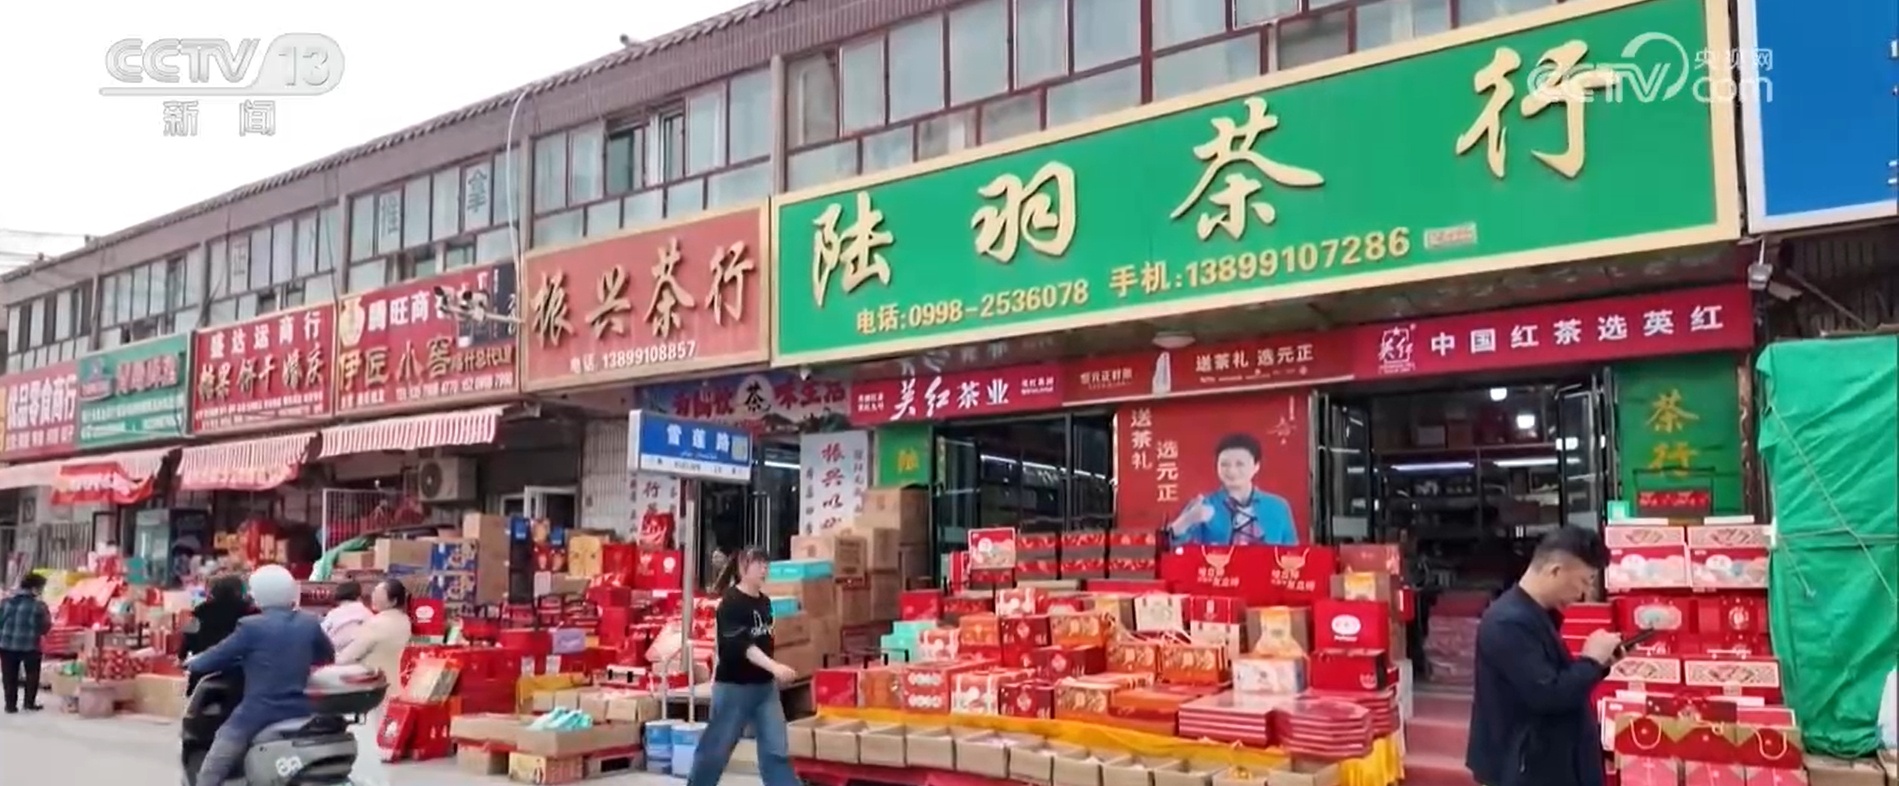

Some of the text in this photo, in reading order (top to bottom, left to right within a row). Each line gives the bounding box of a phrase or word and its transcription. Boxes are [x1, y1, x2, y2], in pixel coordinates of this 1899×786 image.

[812, 39, 1617, 307] 陆羽茶行
[532, 237, 755, 348] 振兴茶行
[1109, 227, 1410, 298] 手机:13899107286
[1430, 304, 1724, 357] 中国红茶选英红
[667, 423, 730, 453] 雪莲路
[1130, 408, 1153, 471] 送茶礼
[1156, 440, 1179, 502] 选元正
